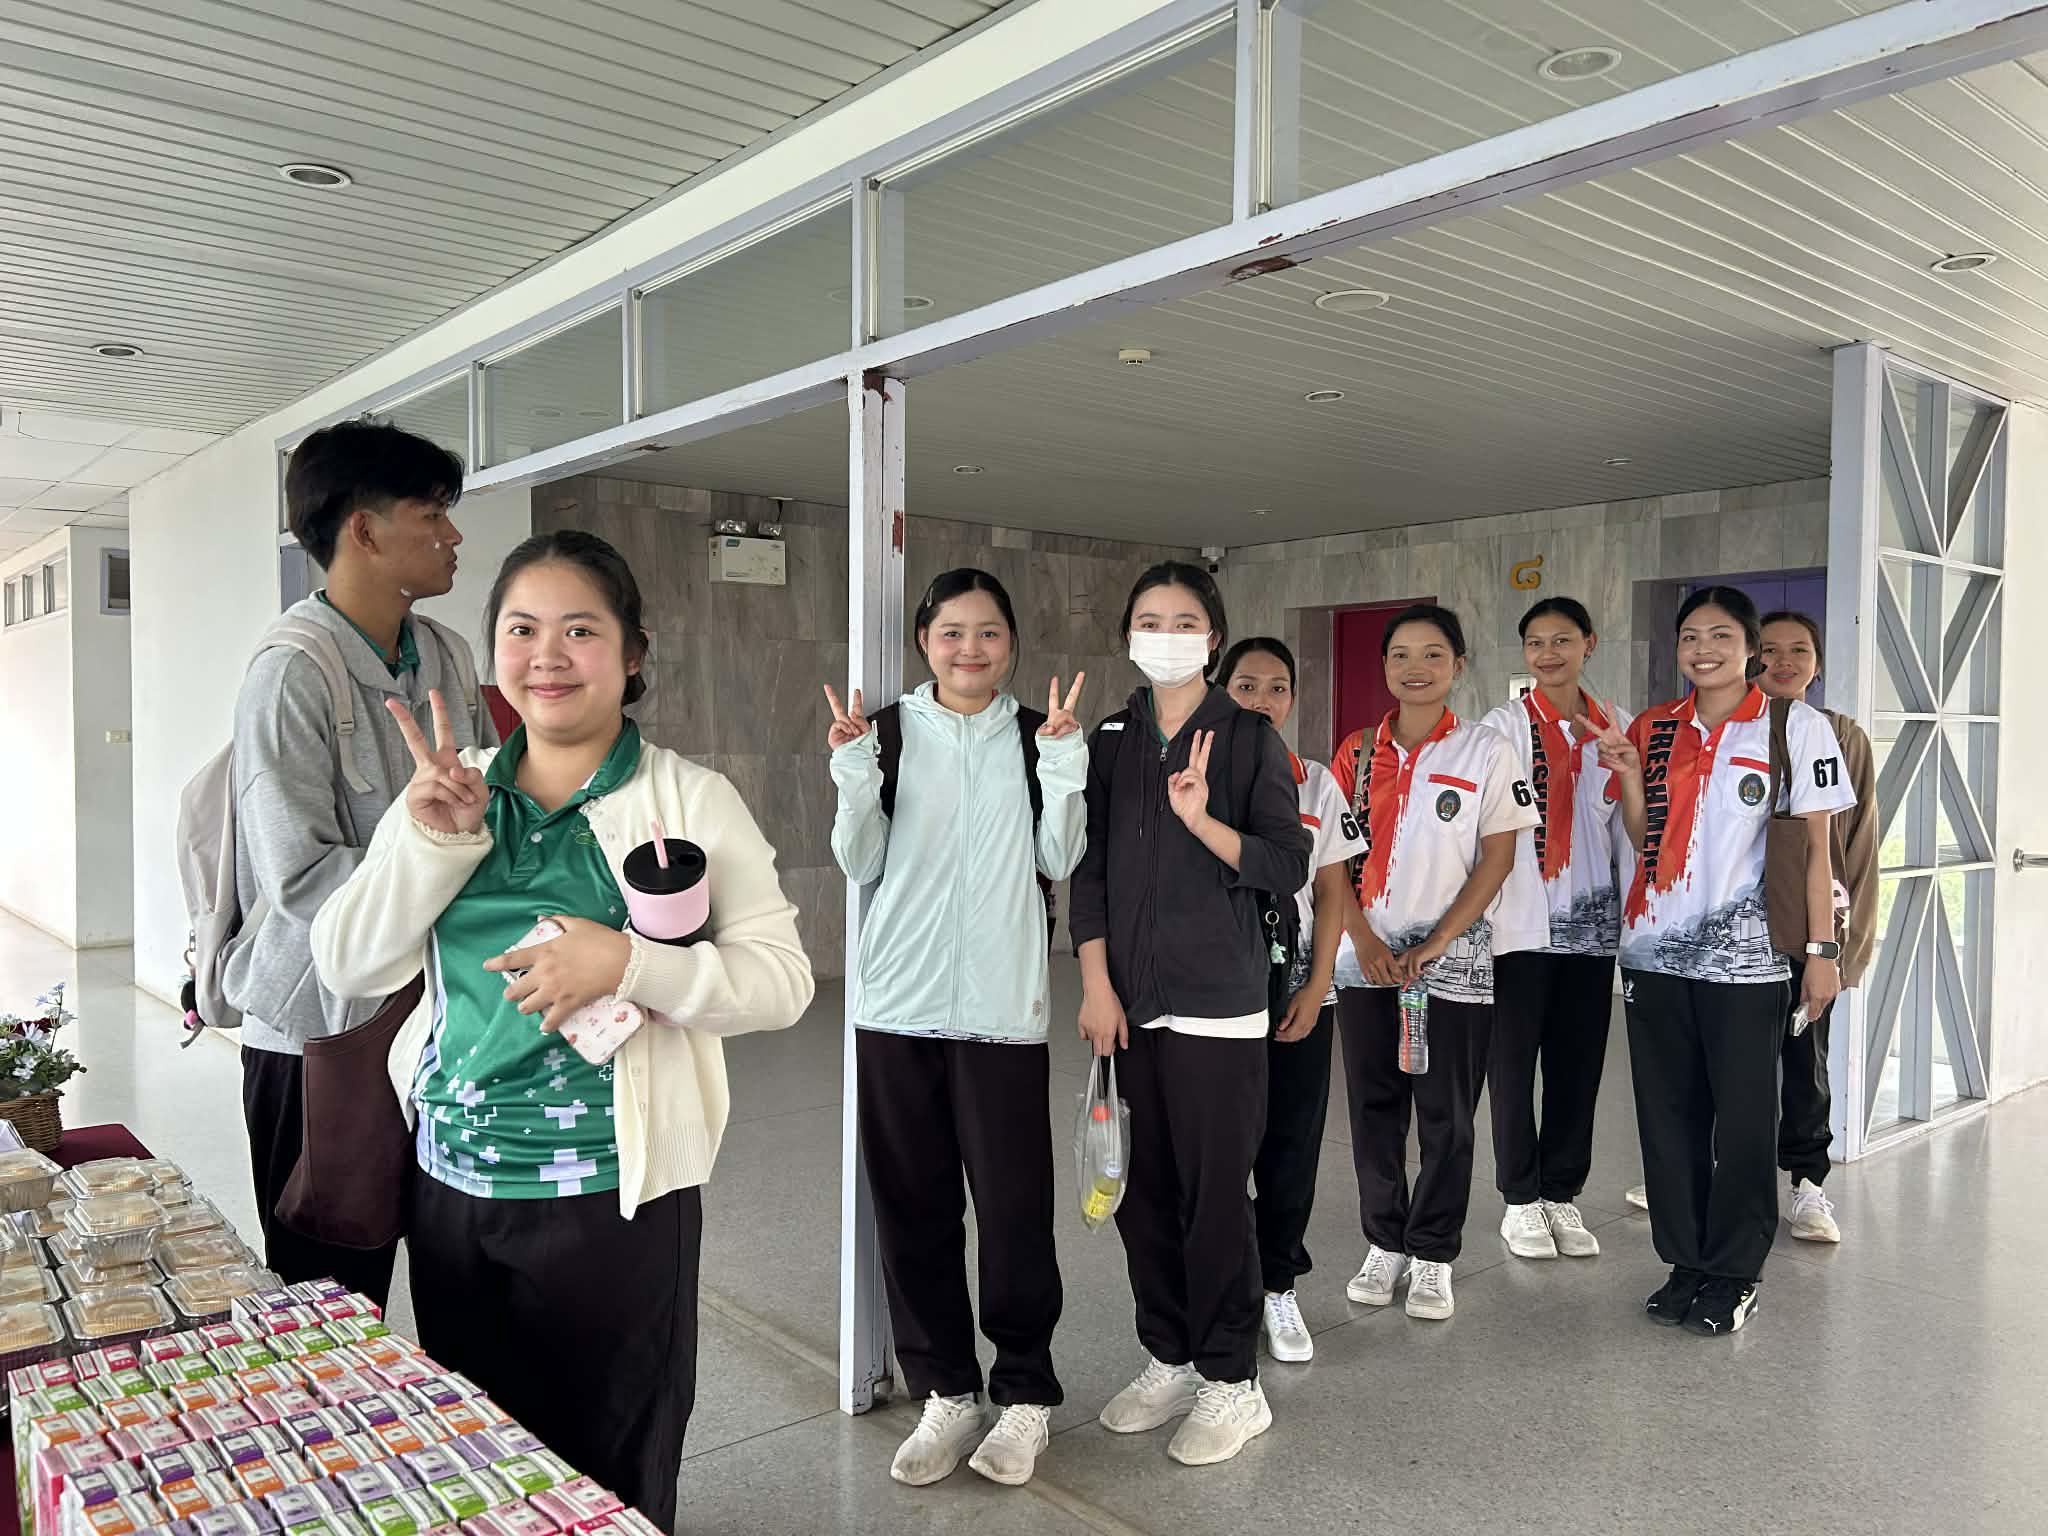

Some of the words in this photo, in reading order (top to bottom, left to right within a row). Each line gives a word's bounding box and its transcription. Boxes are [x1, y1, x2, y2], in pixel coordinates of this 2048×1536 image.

[1511, 554, 1543, 590] ๘
[1812, 756, 1839, 789] 67
[1511, 779, 1533, 807] 6
[1643, 719, 1679, 867] FRESHMEN
